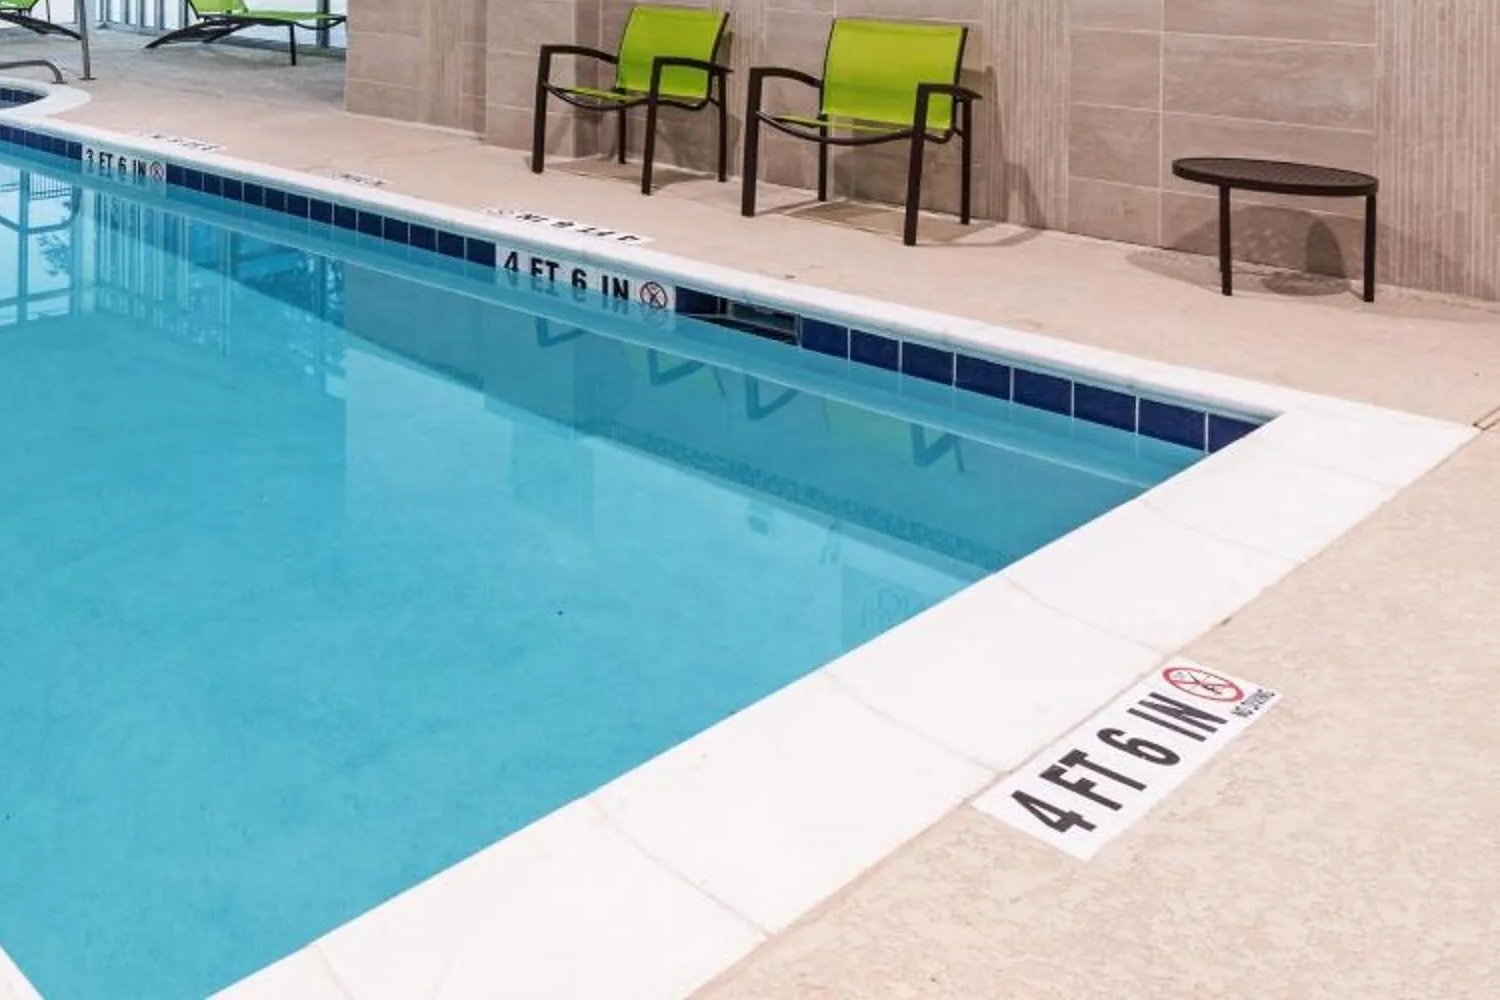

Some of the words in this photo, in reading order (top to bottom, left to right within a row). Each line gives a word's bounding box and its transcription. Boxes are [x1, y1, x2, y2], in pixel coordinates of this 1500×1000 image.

[99, 151, 113, 168] FT
[133, 159, 147, 177] IN
[504, 251, 519, 273] 4
[530, 257, 560, 282] FT
[571, 268, 588, 290] 6
[601, 275, 630, 301] IN
[1126, 691, 1229, 743] IN
[1096, 727, 1181, 767] 6
[1038, 748, 1148, 812] FT
[1010, 789, 1097, 834] 4
